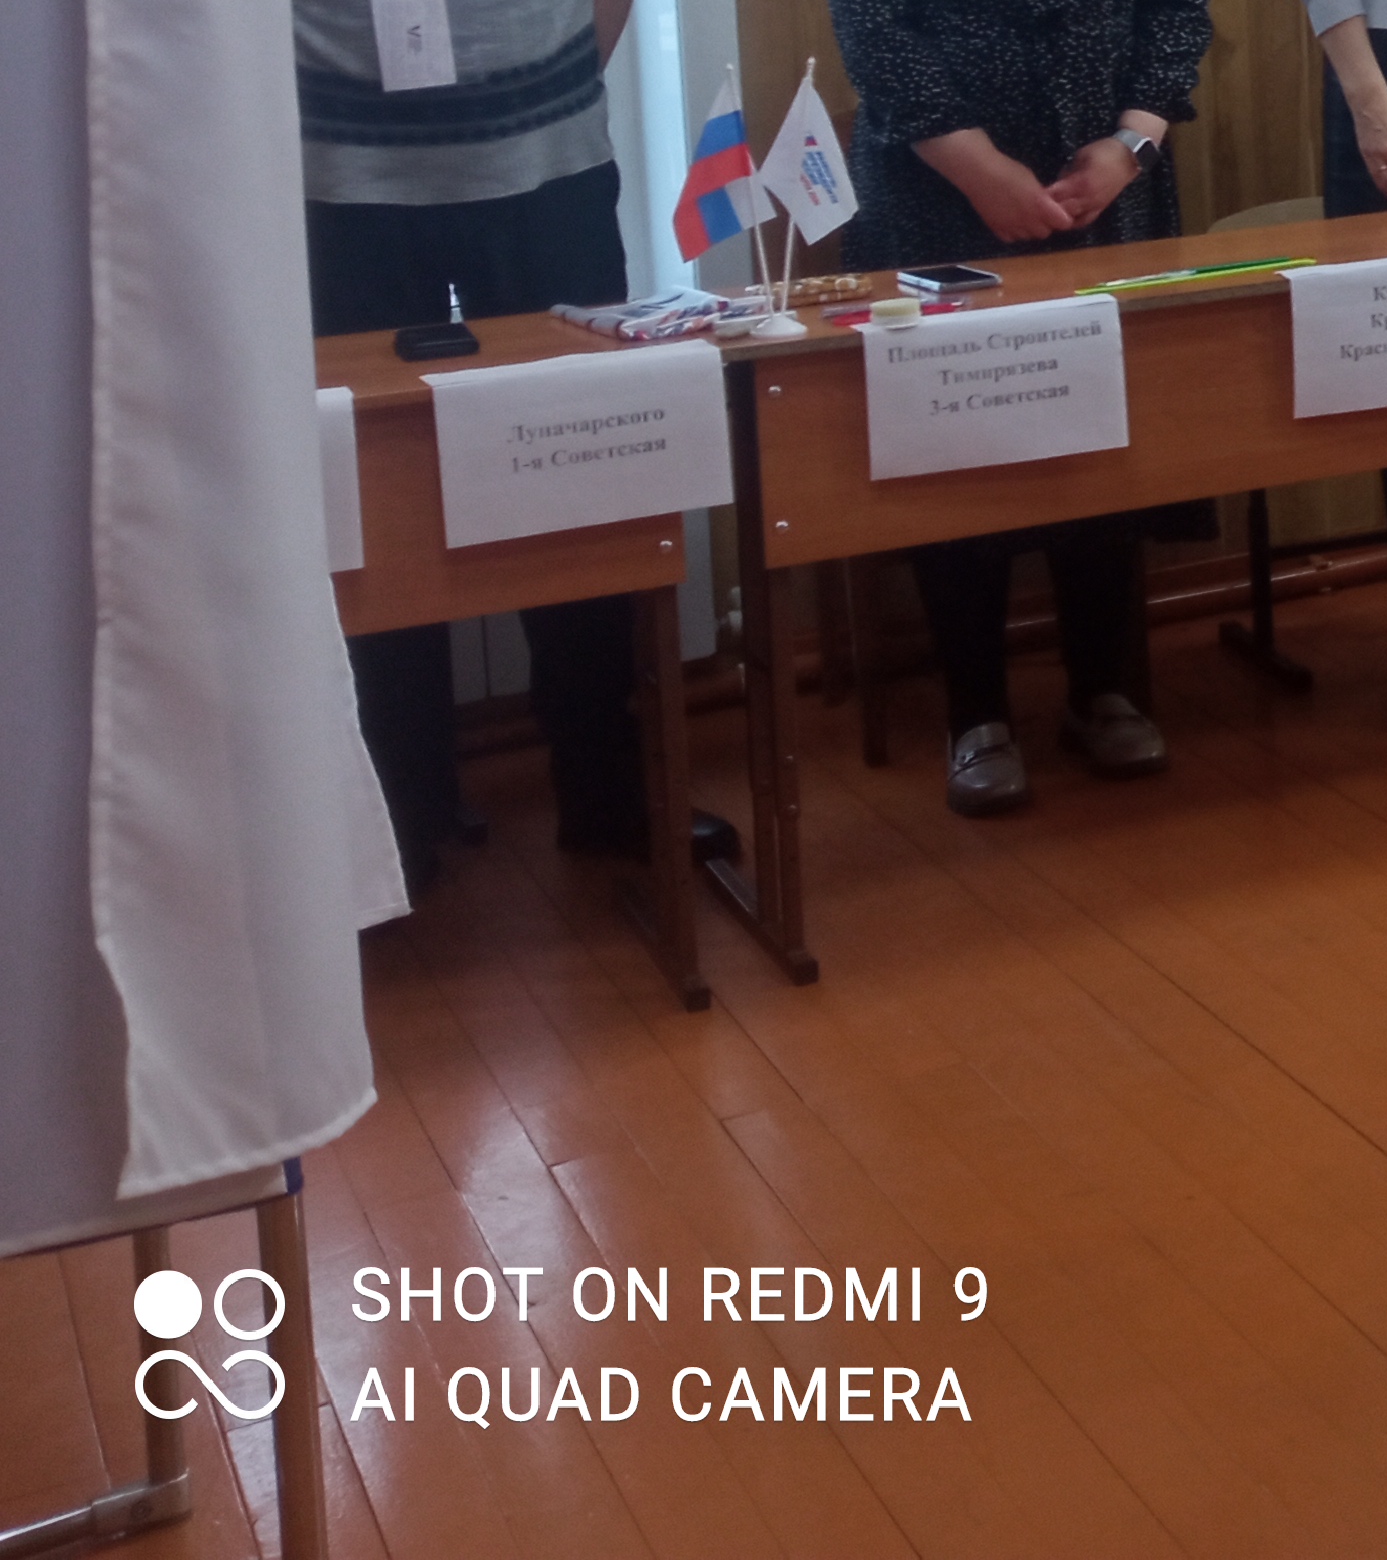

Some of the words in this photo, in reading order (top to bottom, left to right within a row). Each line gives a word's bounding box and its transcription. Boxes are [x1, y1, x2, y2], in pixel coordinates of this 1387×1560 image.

[888, 343, 982, 364] Площадь
[987, 320, 1103, 351] Строителей
[938, 358, 1060, 386] Тимирязева
[929, 398, 960, 416] 3-я
[966, 385, 1071, 411] Советская
[507, 408, 666, 445] Луначарского
[511, 456, 543, 474] 1-я
[550, 438, 667, 468] Советская
